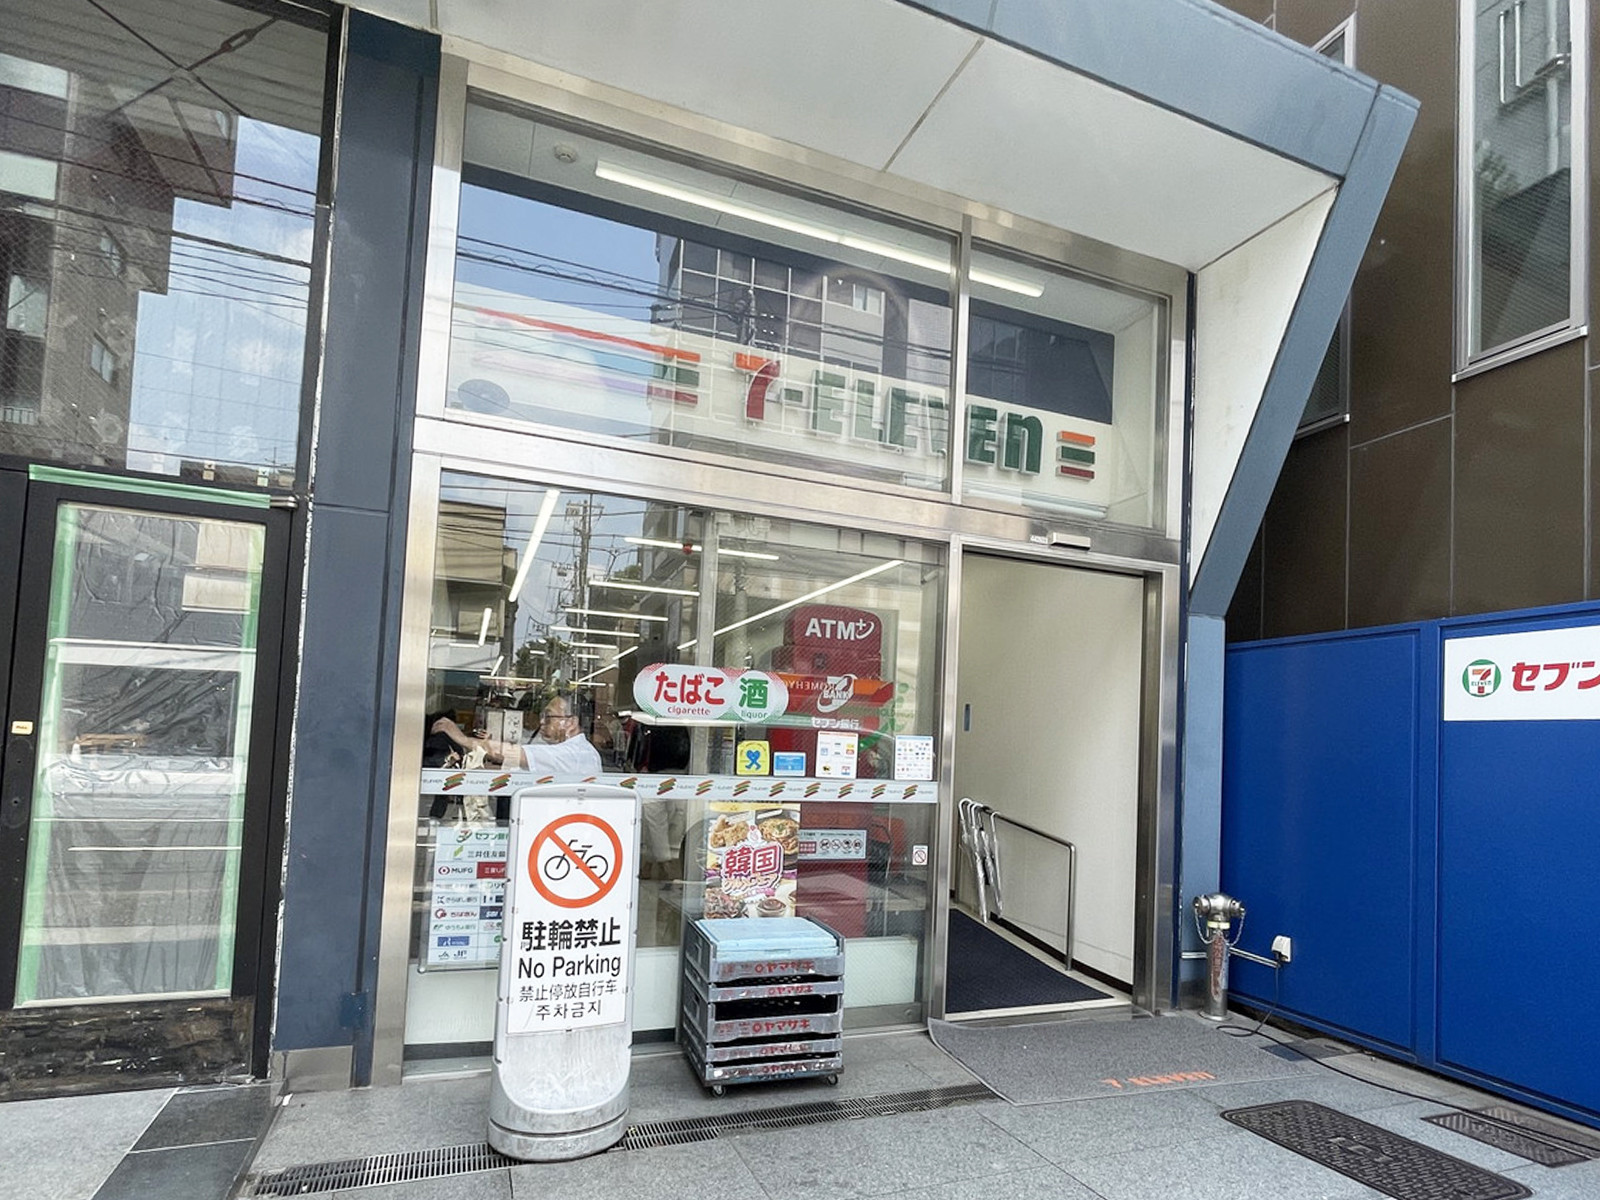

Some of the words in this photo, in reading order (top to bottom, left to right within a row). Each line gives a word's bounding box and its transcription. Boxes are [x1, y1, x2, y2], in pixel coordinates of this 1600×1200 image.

[654, 671, 725, 705] たばこ
[738, 677, 769, 709] 酒
[667, 705, 711, 715] cigarette
[741, 710, 768, 719] liquor
[725, 846, 778, 878] 韓国
[520, 917, 621, 951] 駐輪禁止
[518, 957, 545, 979] No
[552, 953, 621, 977] Parking
[519, 980, 618, 1002] 禁止停放自行车
[536, 1000, 602, 1021] 주차금지
